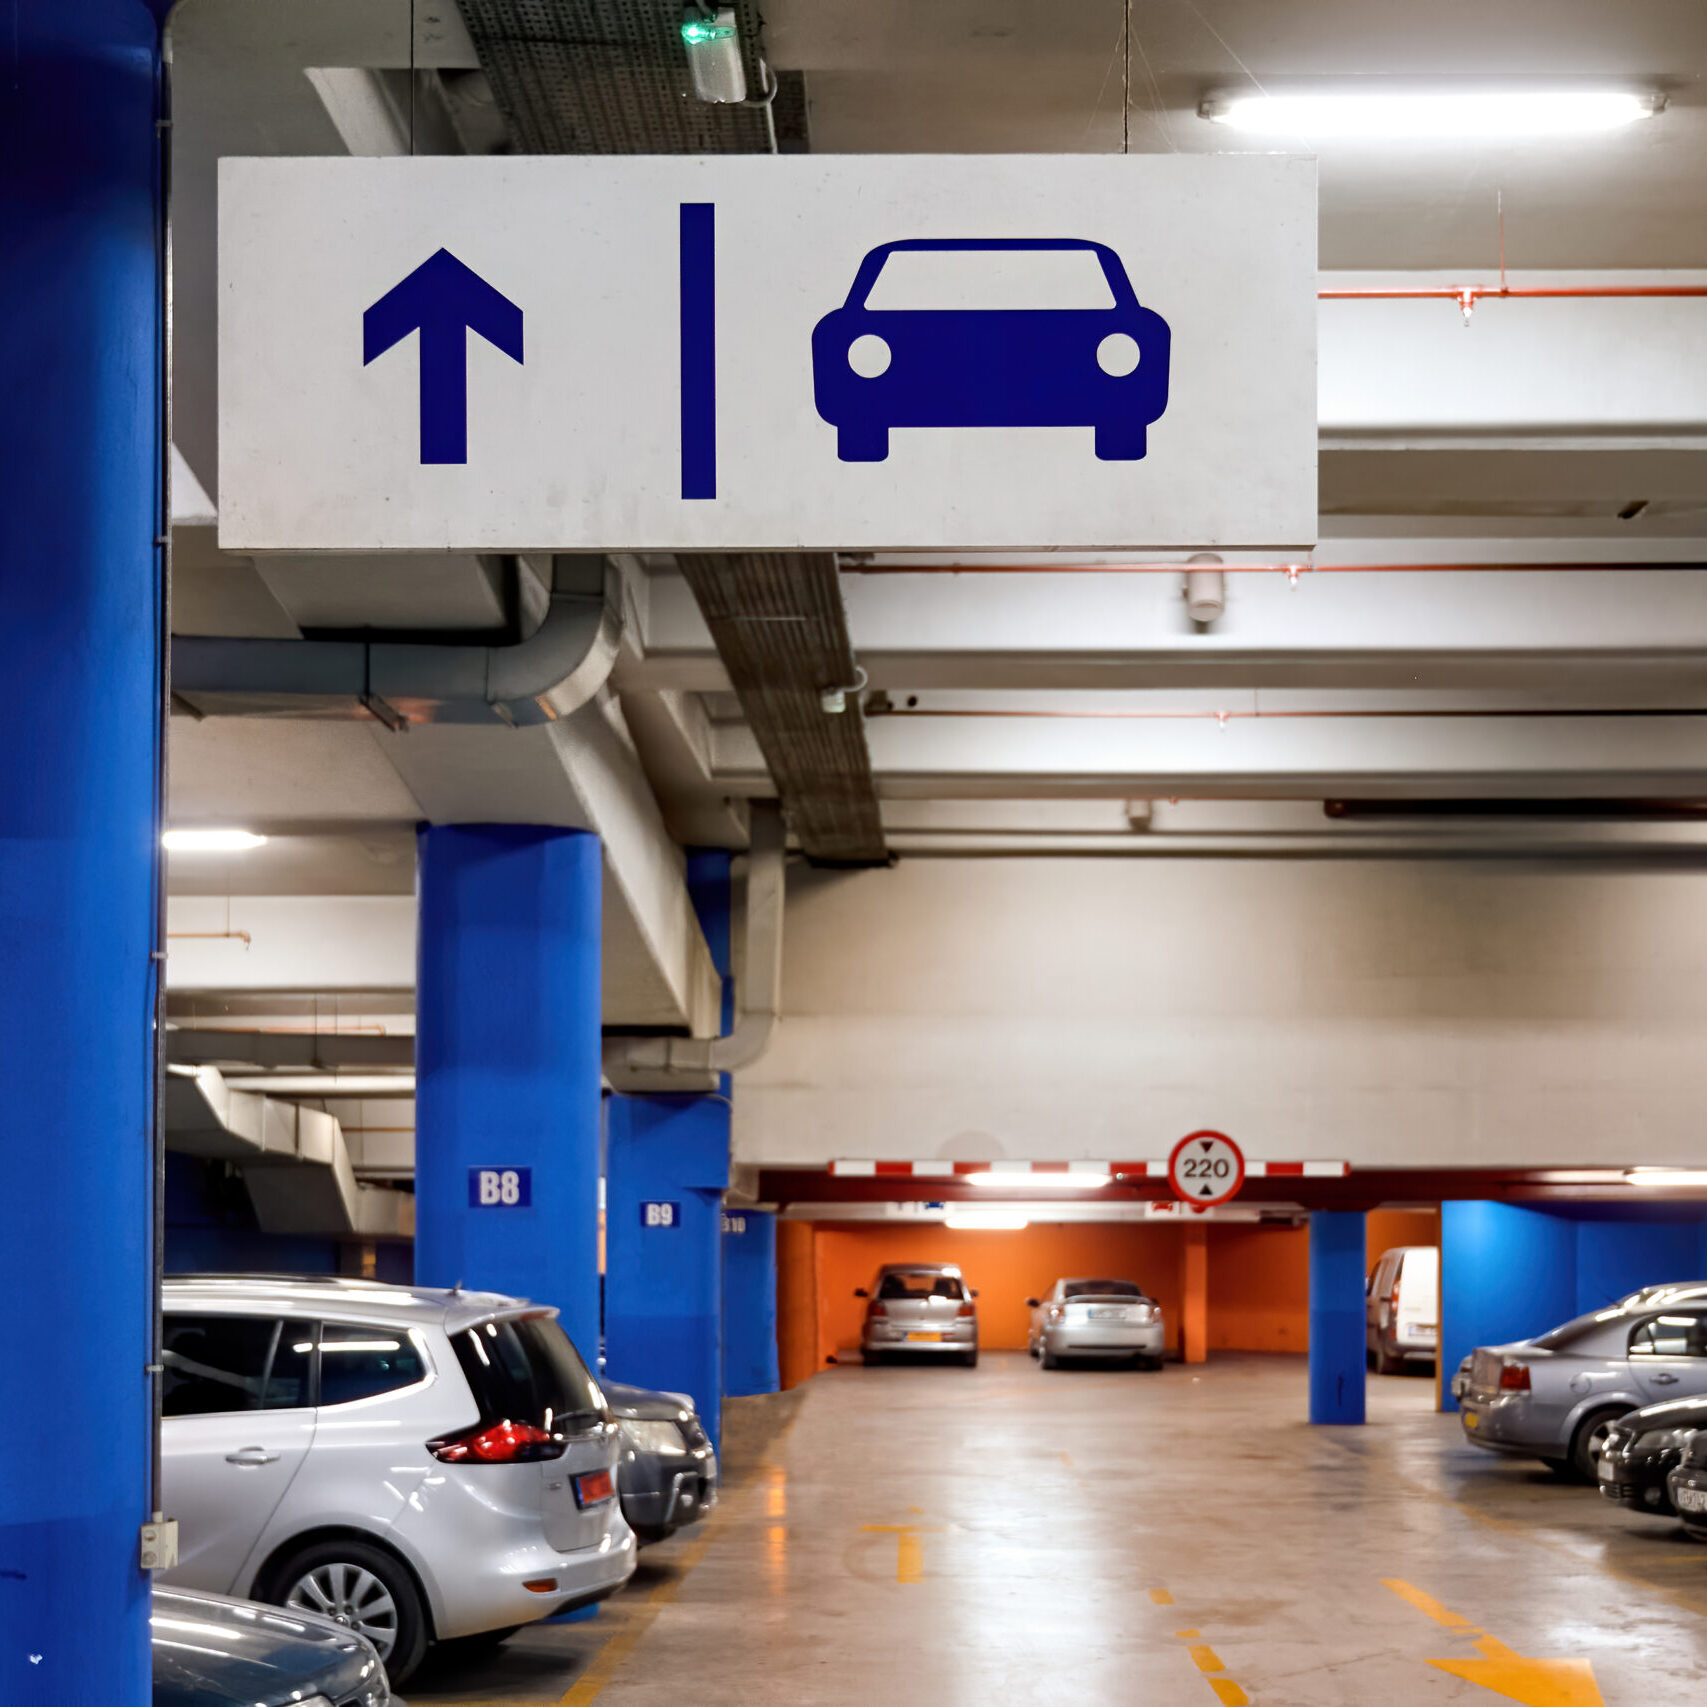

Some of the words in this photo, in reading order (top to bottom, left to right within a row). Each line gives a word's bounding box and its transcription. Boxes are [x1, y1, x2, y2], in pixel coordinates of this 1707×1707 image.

[1183, 1158, 1230, 1178] 220
[479, 1170, 520, 1205] B8
[645, 1203, 673, 1226] B9
